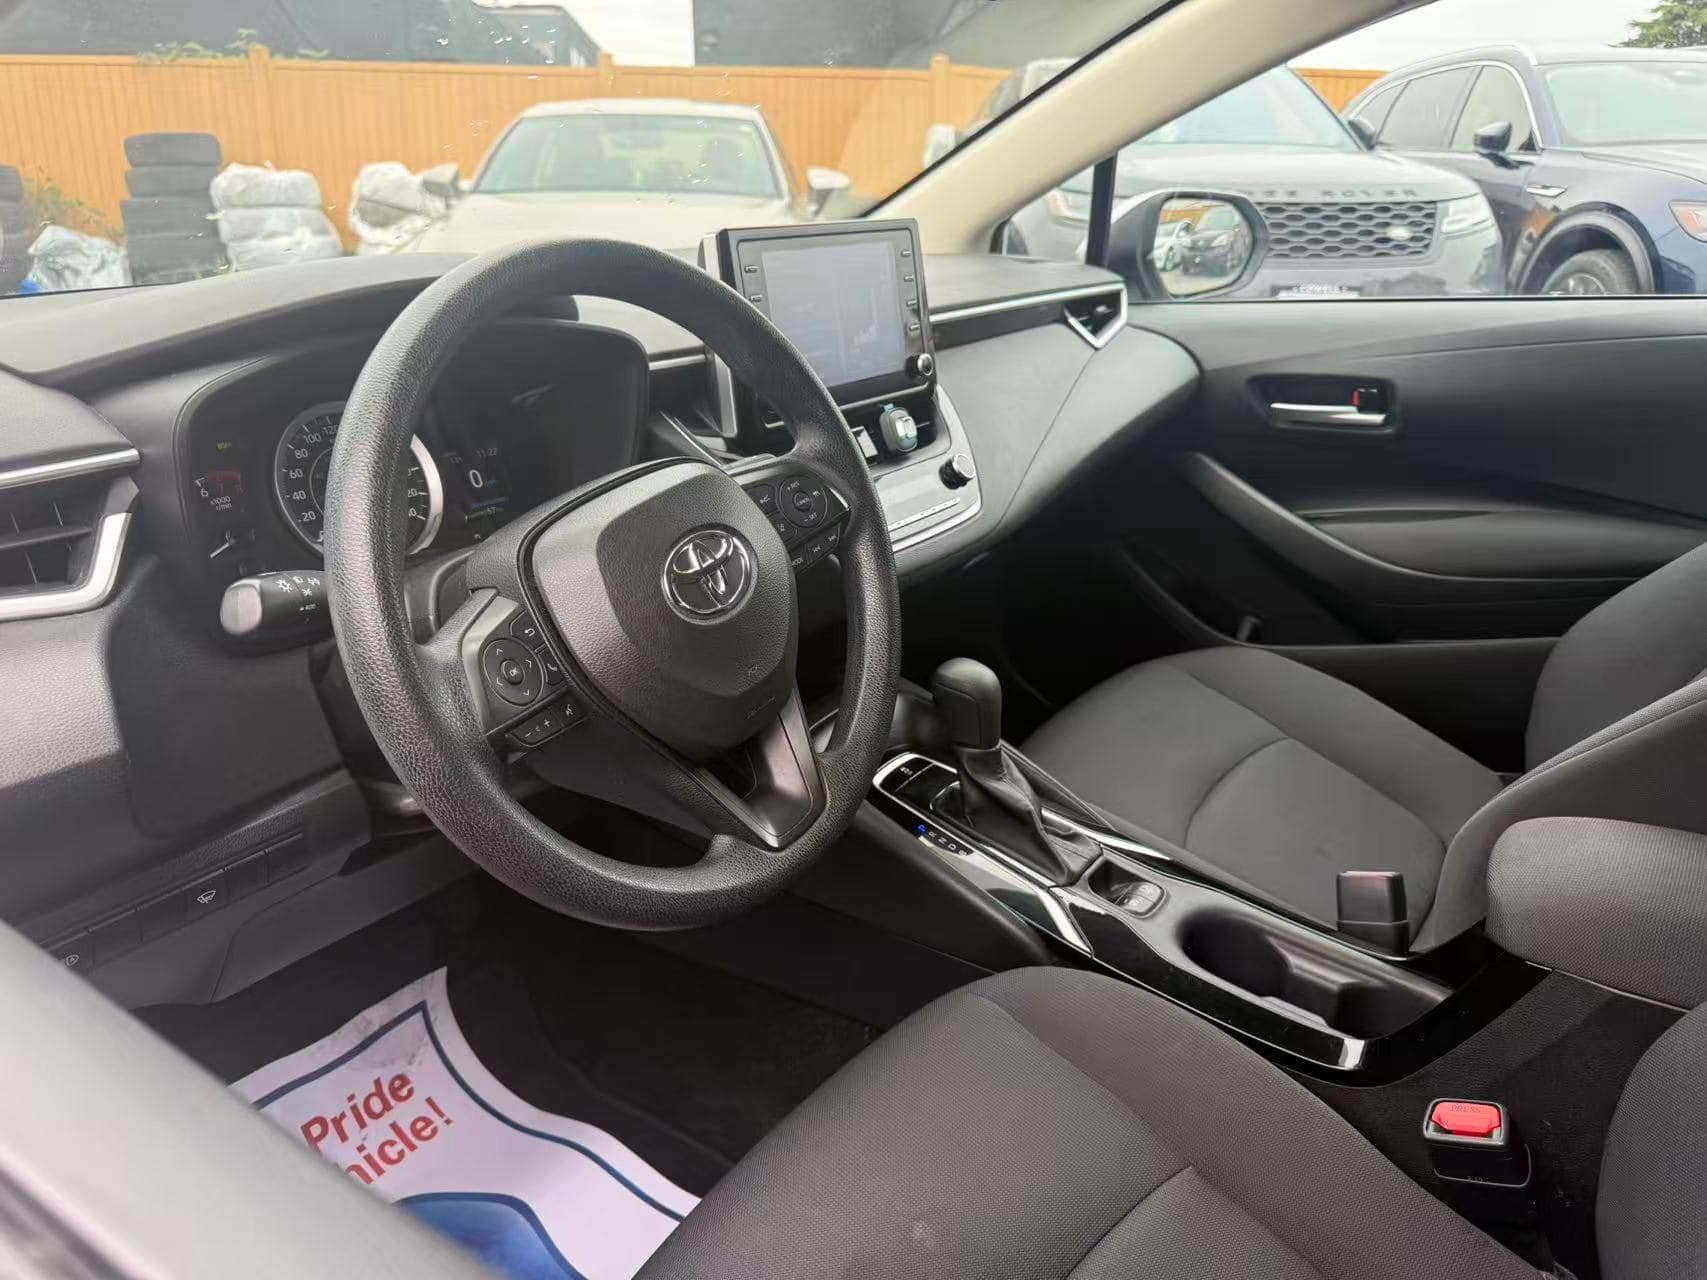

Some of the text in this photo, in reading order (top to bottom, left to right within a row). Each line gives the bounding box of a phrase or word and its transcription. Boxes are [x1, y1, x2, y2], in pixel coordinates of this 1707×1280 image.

[1320, 188, 1417, 197] ROVER
[303, 433, 321, 444] 100
[294, 448, 309, 459] 80
[289, 468, 304, 479] 60
[469, 469, 483, 488] 0
[200, 487, 209, 497] 6
[292, 490, 307, 500] 40
[301, 510, 316, 521] 20
[301, 1073, 415, 1153] Pride
[1450, 1104, 1481, 1114] PRESS
